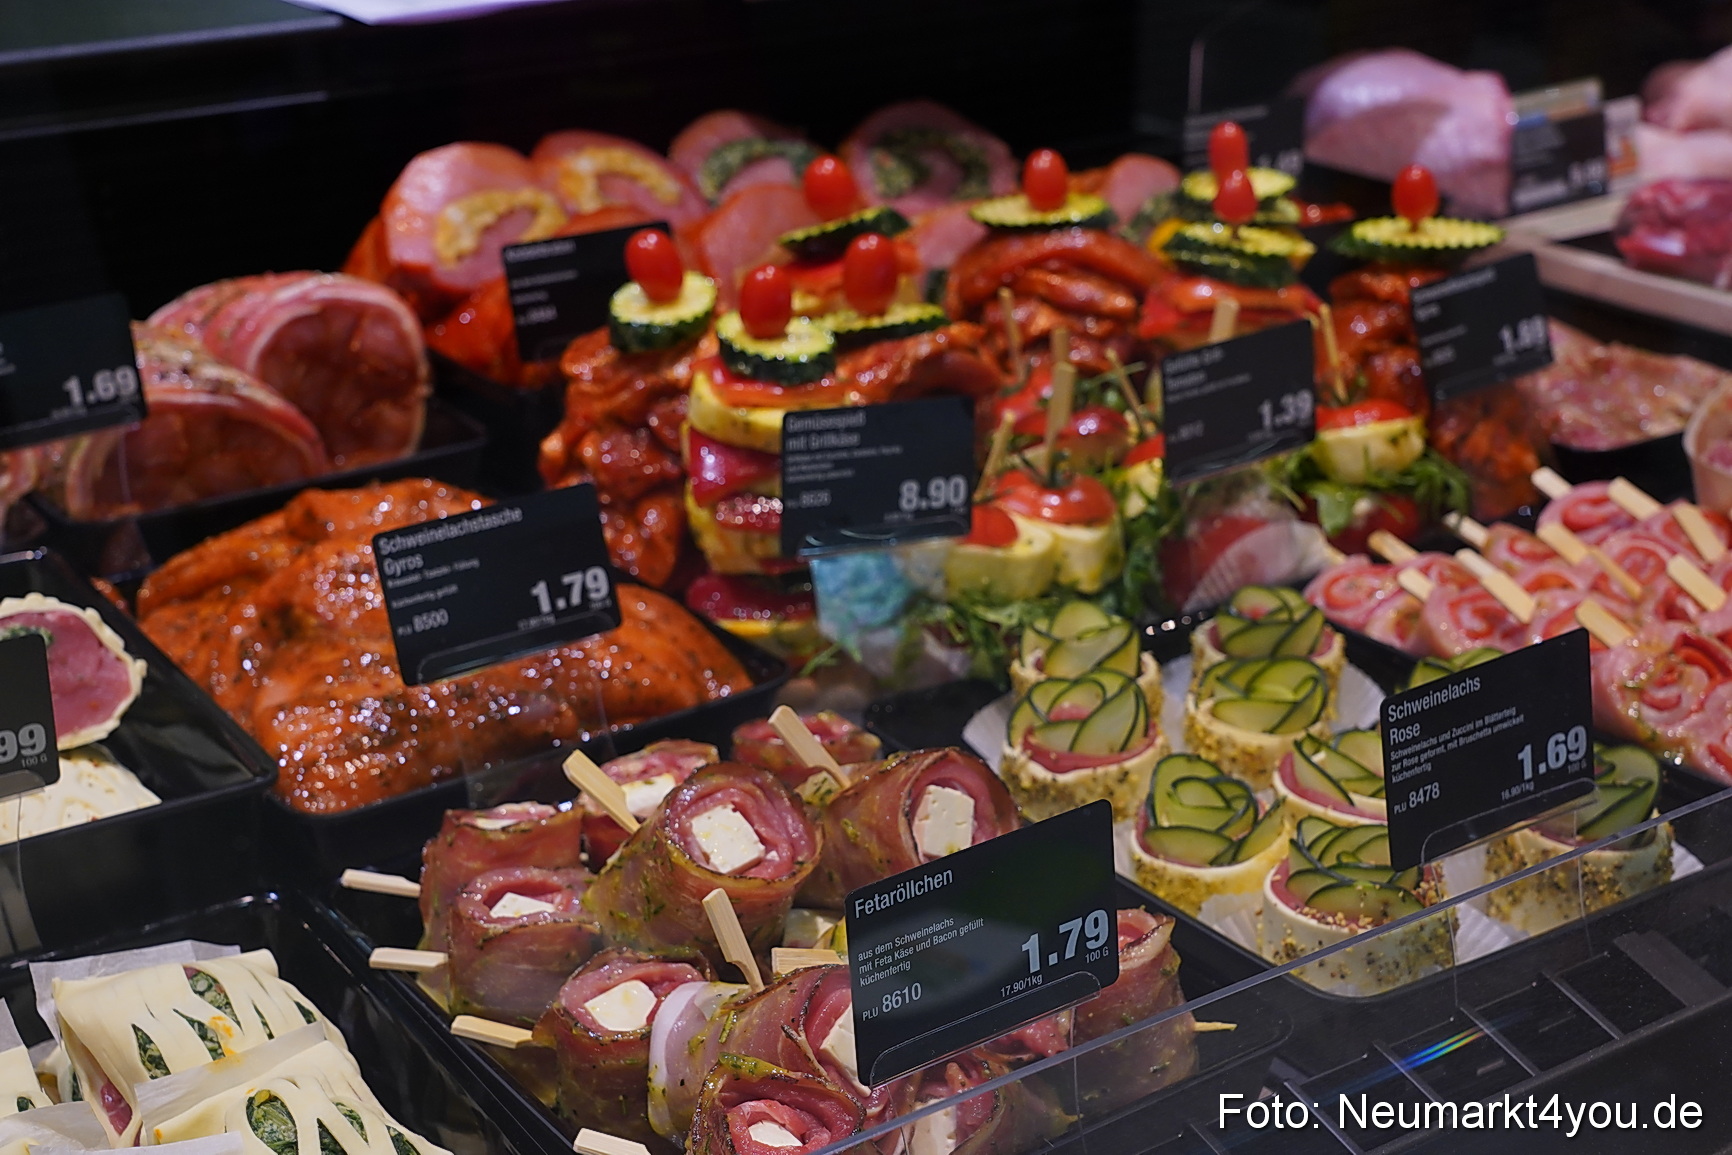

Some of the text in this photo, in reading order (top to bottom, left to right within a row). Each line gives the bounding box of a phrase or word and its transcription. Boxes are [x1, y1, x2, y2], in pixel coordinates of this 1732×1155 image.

[62, 365, 138, 407] 1.69
[899, 474, 968, 512] 8.90
[379, 507, 522, 555] Schweinelachstasche
[383, 553, 424, 577] Gyros
[530, 565, 609, 614] 1.79
[413, 608, 448, 632] 8500
[1388, 677, 1480, 722] Schweinelachs
[1389, 722, 1420, 746] Rose
[1390, 706, 1516, 761] Schweinelachs und Zuccini im Blätterteig
[1391, 714, 1524, 772] zur Rose geformt, mit Bruschetta umwickelt
[1517, 725, 1587, 780] 1.69
[21, 753, 47, 768] 100 G
[1391, 762, 1432, 784] küchenfertig
[1394, 781, 1440, 815] PLU 8478
[1501, 780, 1535, 800] 16.90/1kg
[854, 869, 953, 918] Fetaröllchen
[858, 917, 954, 961] aus dem Schweinelachs
[859, 917, 984, 974] mit Feta Käse und Bacon gefüllt
[1021, 909, 1109, 974] 1.79
[1085, 947, 1109, 964] 100 G
[860, 960, 911, 987] küchenfertig
[1000, 974, 1043, 998] 17.90/1kg
[862, 982, 922, 1021] PLU 8610
